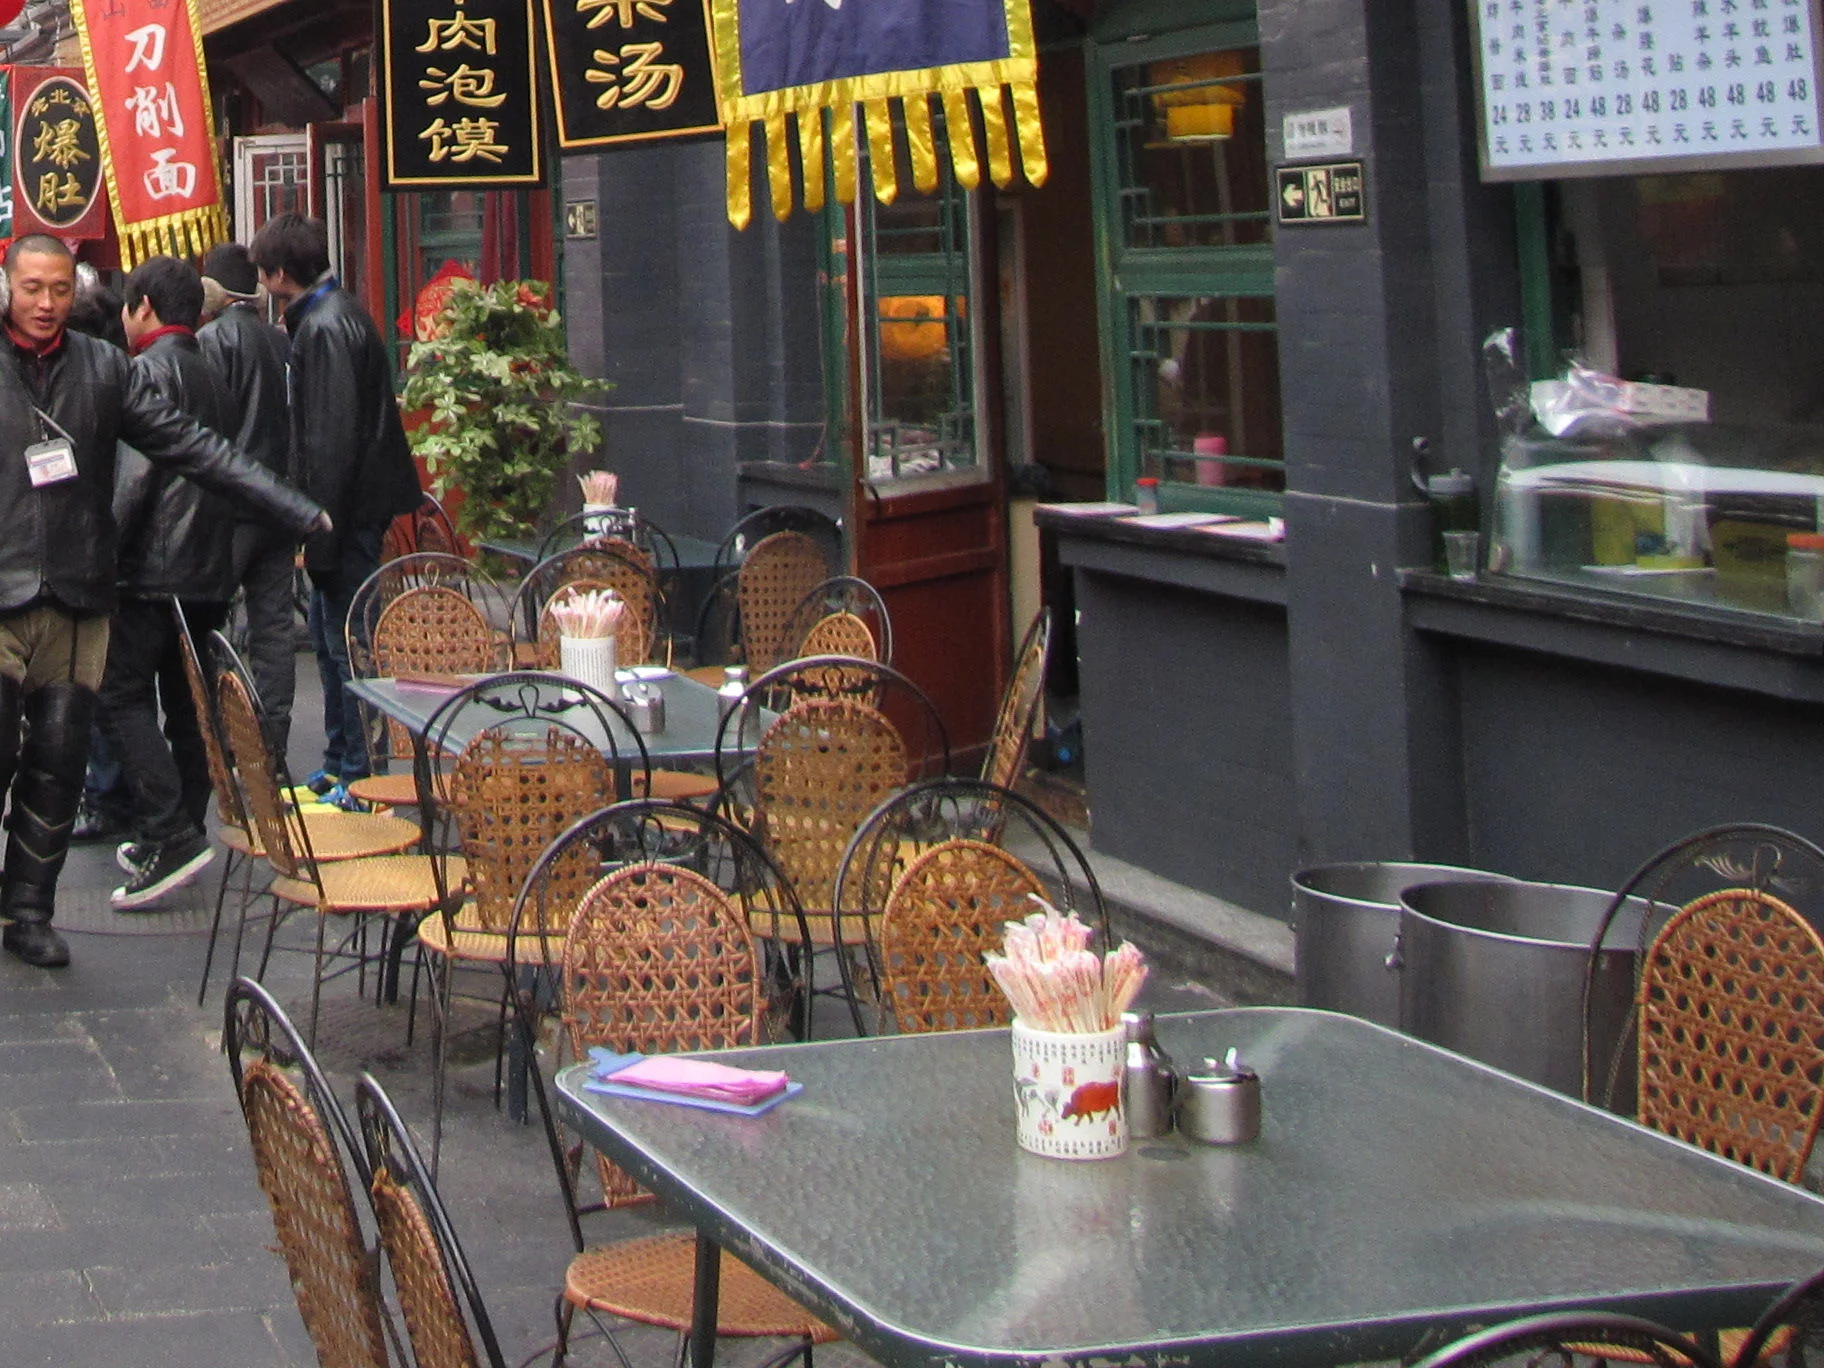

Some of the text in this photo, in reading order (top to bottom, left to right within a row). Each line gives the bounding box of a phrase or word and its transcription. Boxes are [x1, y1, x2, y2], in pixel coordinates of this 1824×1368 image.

[32, 118, 92, 215] 爆肚
[123, 22, 197, 200] 刀削面
